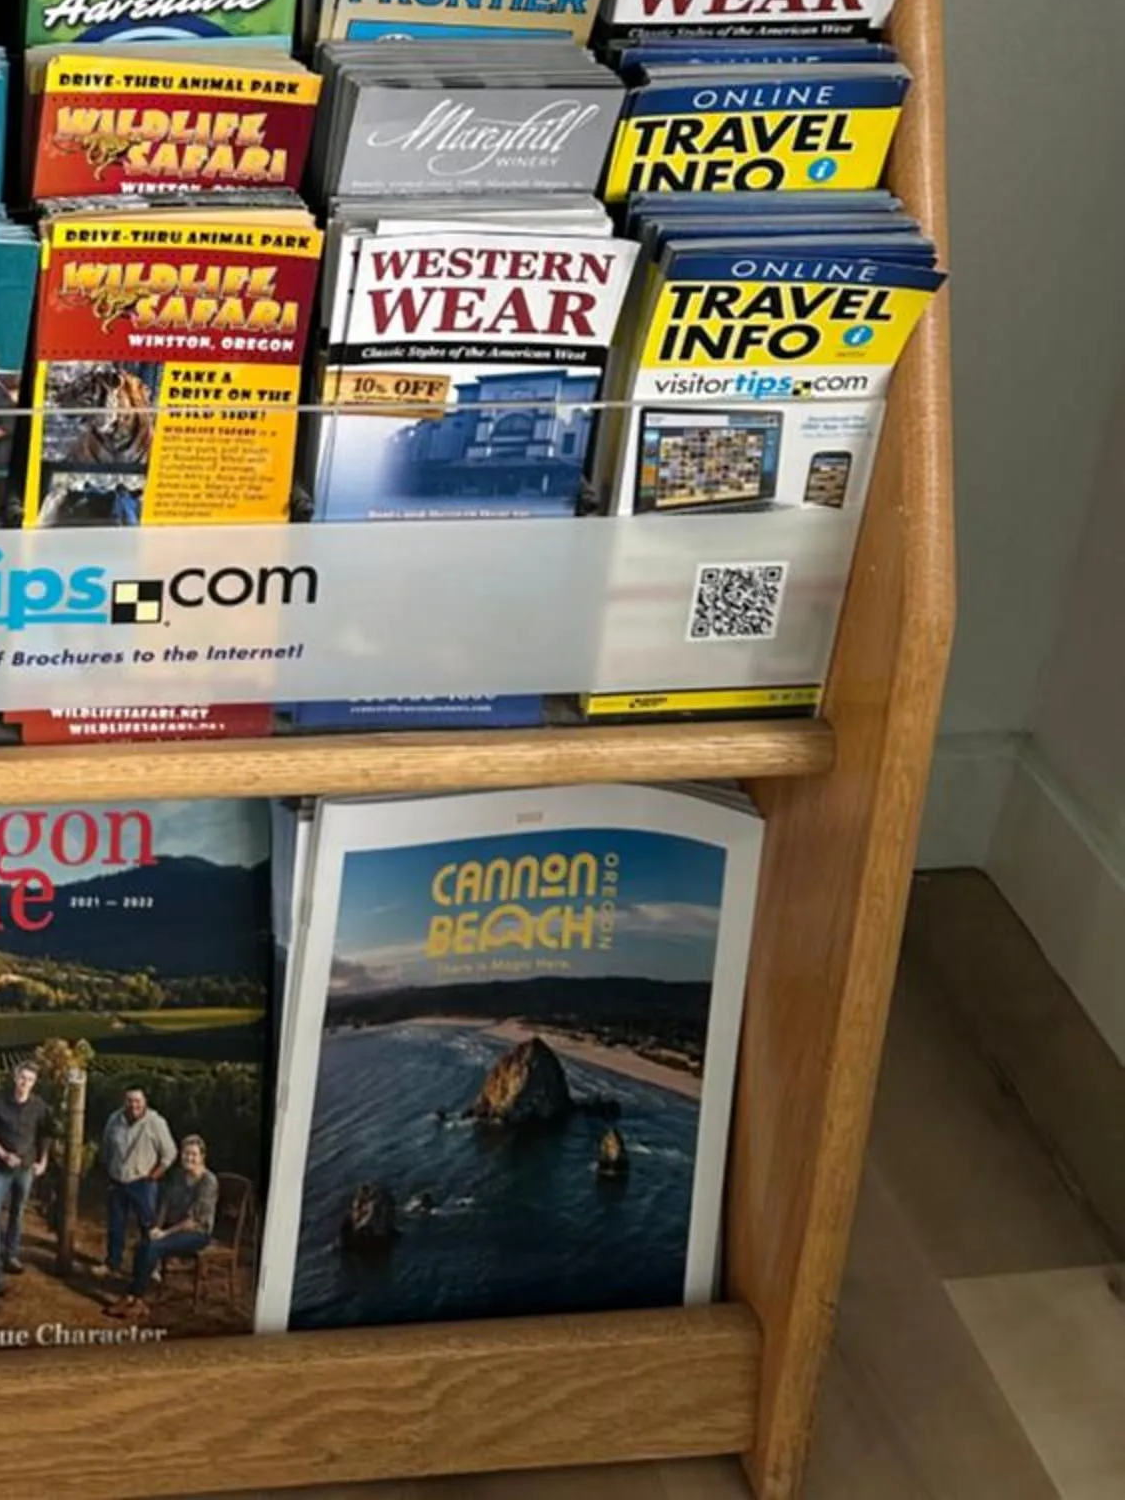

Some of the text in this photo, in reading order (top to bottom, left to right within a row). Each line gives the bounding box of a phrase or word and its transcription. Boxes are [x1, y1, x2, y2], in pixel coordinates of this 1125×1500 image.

[179, 75, 245, 93] ANIMAL
[250, 78, 300, 96] PARK
[693, 84, 835, 108] ONLINE
[55, 106, 267, 144] WILDLIFE
[368, 98, 600, 177] Maryhill
[633, 113, 853, 156] TRAVEL
[123, 142, 288, 185] SAFARI
[496, 157, 559, 169] WINERY
[361, 346, 587, 360] Classic Styles of the American West
[657, 326, 822, 361] INFO
[171, 370, 233, 383] TAKE A
[169, 387, 292, 401] DRIVE ON THE
[12, 648, 124, 669] Brochures
[133, 648, 155, 664] to
[163, 644, 199, 663] the
[206, 643, 304, 661] Internet!
[432, 852, 598, 906] CANNON
[598, 852, 620, 950] OREGON
[425, 903, 595, 958] BEACH
[36, 1322, 168, 1345] Character
